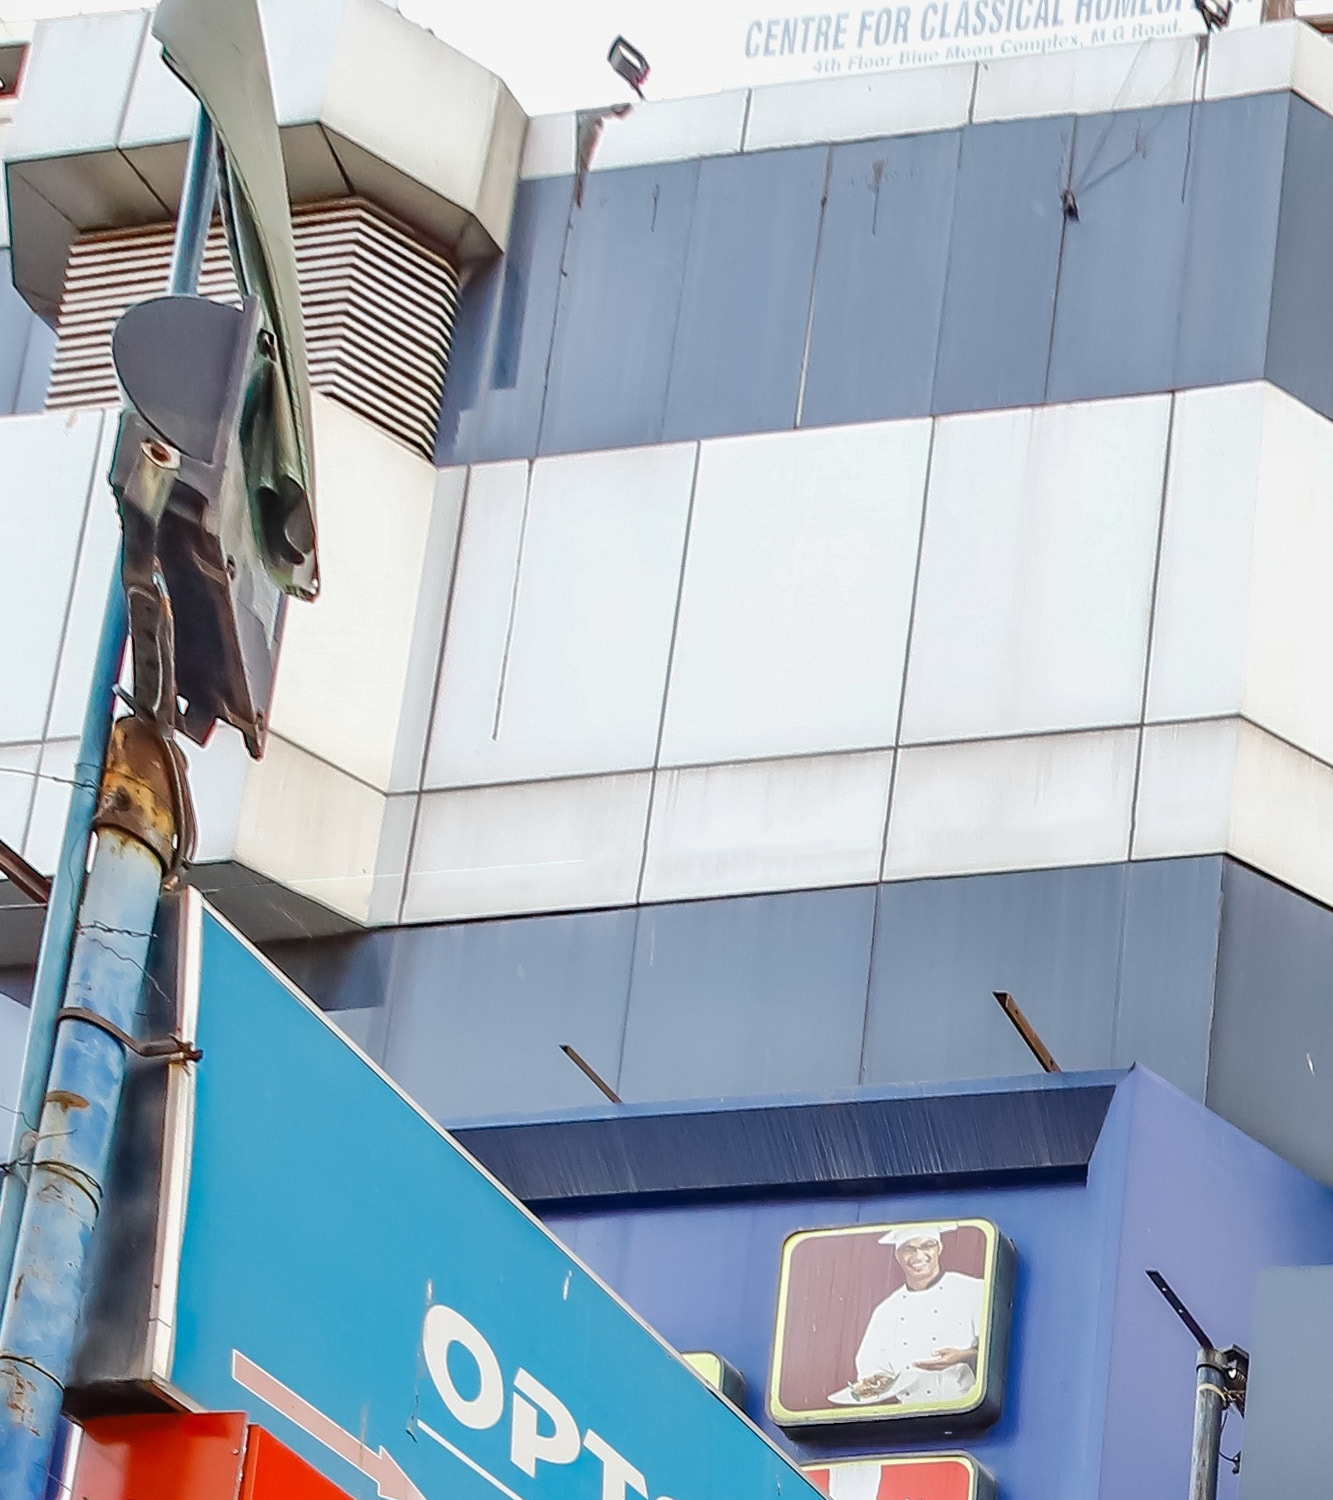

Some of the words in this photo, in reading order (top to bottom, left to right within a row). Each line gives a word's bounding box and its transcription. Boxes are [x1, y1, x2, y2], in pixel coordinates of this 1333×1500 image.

[744, 12, 850, 59] CENTRE
[856, 5, 911, 49] FOR
[920, 0, 1064, 41] CLASSICAL
[848, 54, 894, 72] Floor
[945, 44, 995, 61] Moon
